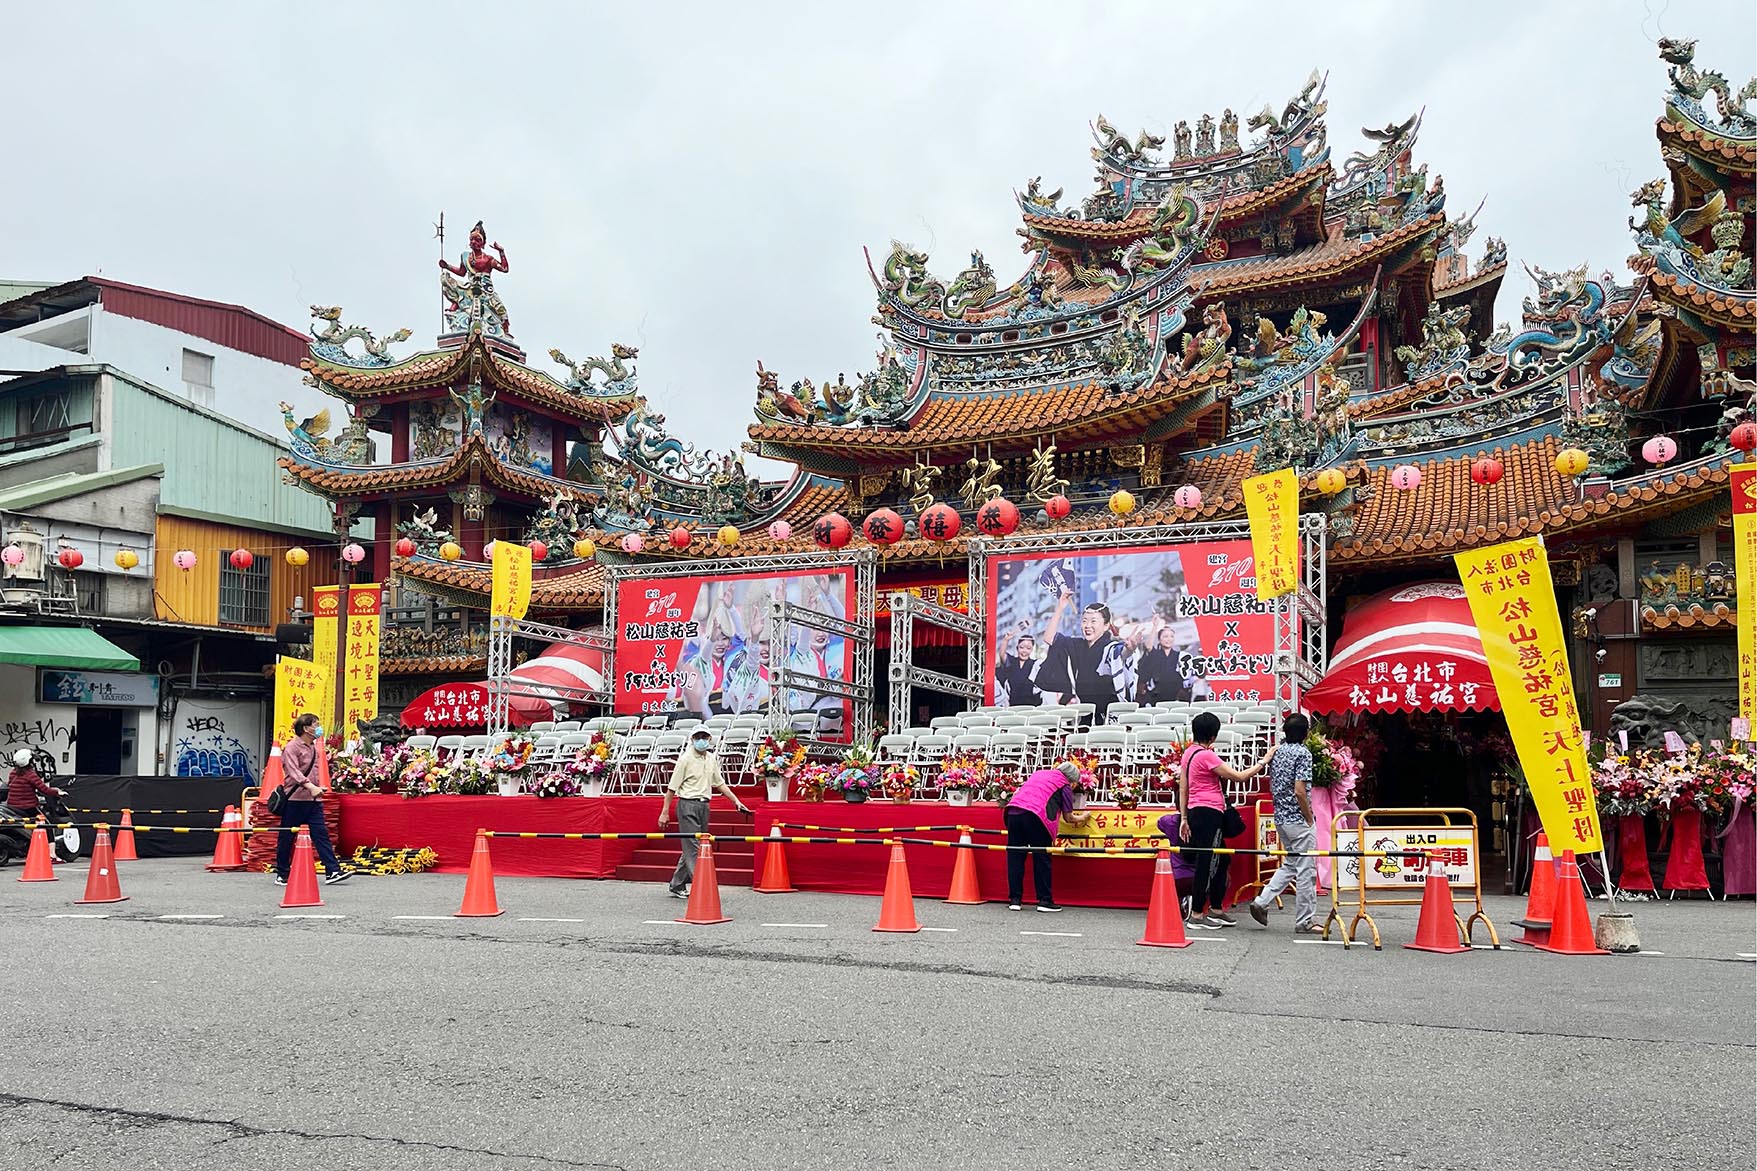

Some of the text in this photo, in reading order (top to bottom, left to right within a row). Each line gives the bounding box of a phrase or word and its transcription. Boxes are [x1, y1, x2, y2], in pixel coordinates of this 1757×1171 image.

[815, 520, 836, 545] 財
[867, 516, 892, 540] 發
[925, 512, 949, 537] 禧
[1208, 557, 1253, 588] 270
[625, 622, 699, 640] 松山慈祐宮
[1225, 622, 1238, 636] X
[656, 645, 666, 657] X
[1392, 661, 1457, 683] 台北市
[446, 689, 480, 706] 台北市
[1349, 682, 1480, 707] 松山慈祐宮
[1095, 814, 1147, 828] 台北市
[1406, 834, 1436, 844] 出入口
